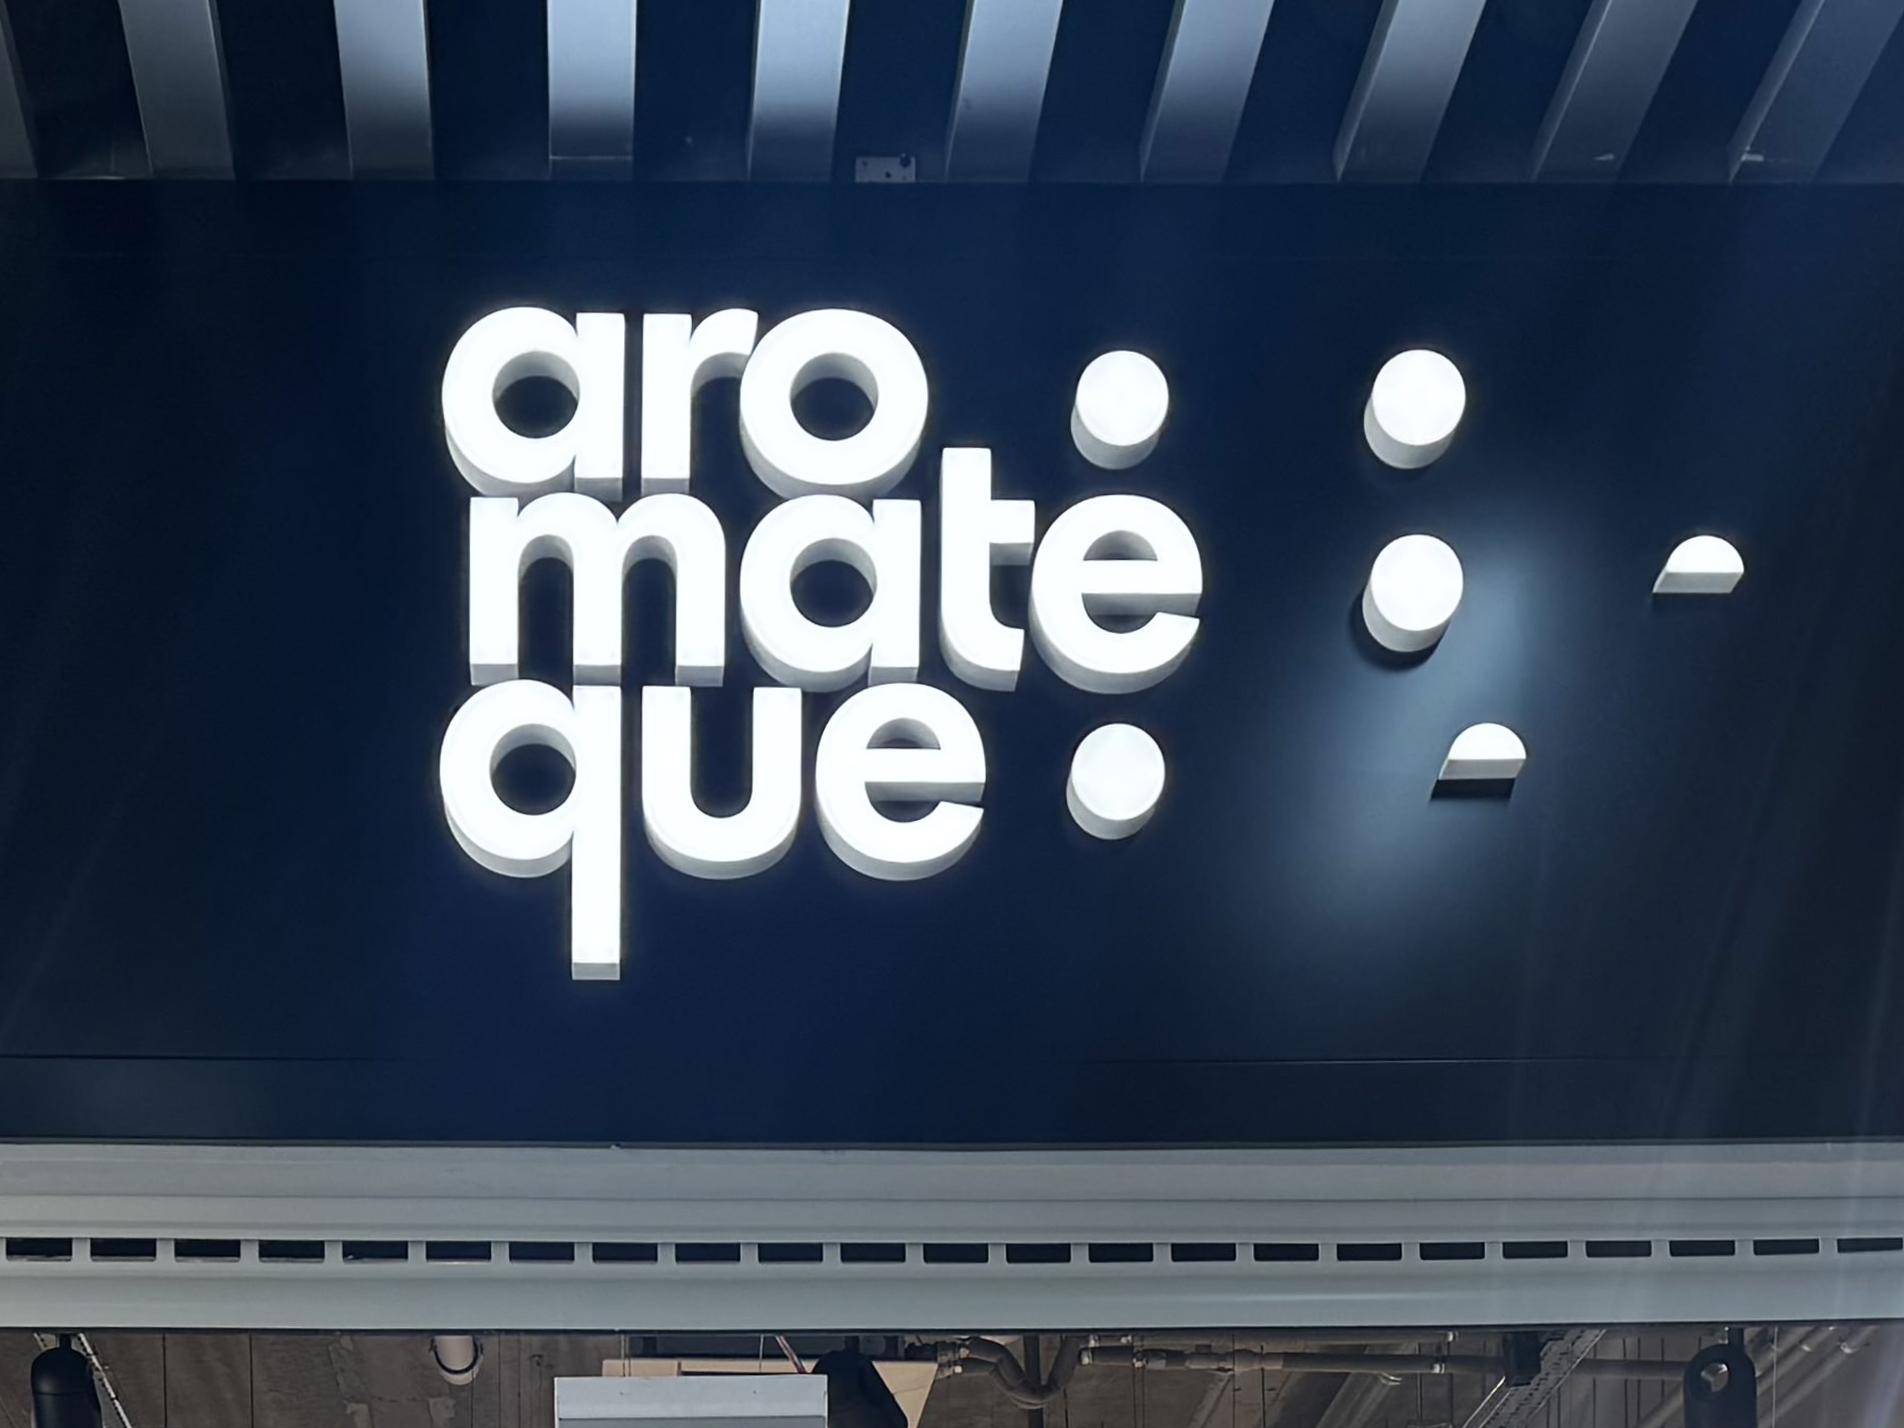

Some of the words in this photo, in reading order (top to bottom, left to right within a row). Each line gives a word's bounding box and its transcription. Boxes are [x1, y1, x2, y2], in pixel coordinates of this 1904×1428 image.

[441, 306, 929, 502] aro
[469, 447, 1203, 694] mate
[440, 679, 987, 981] que
